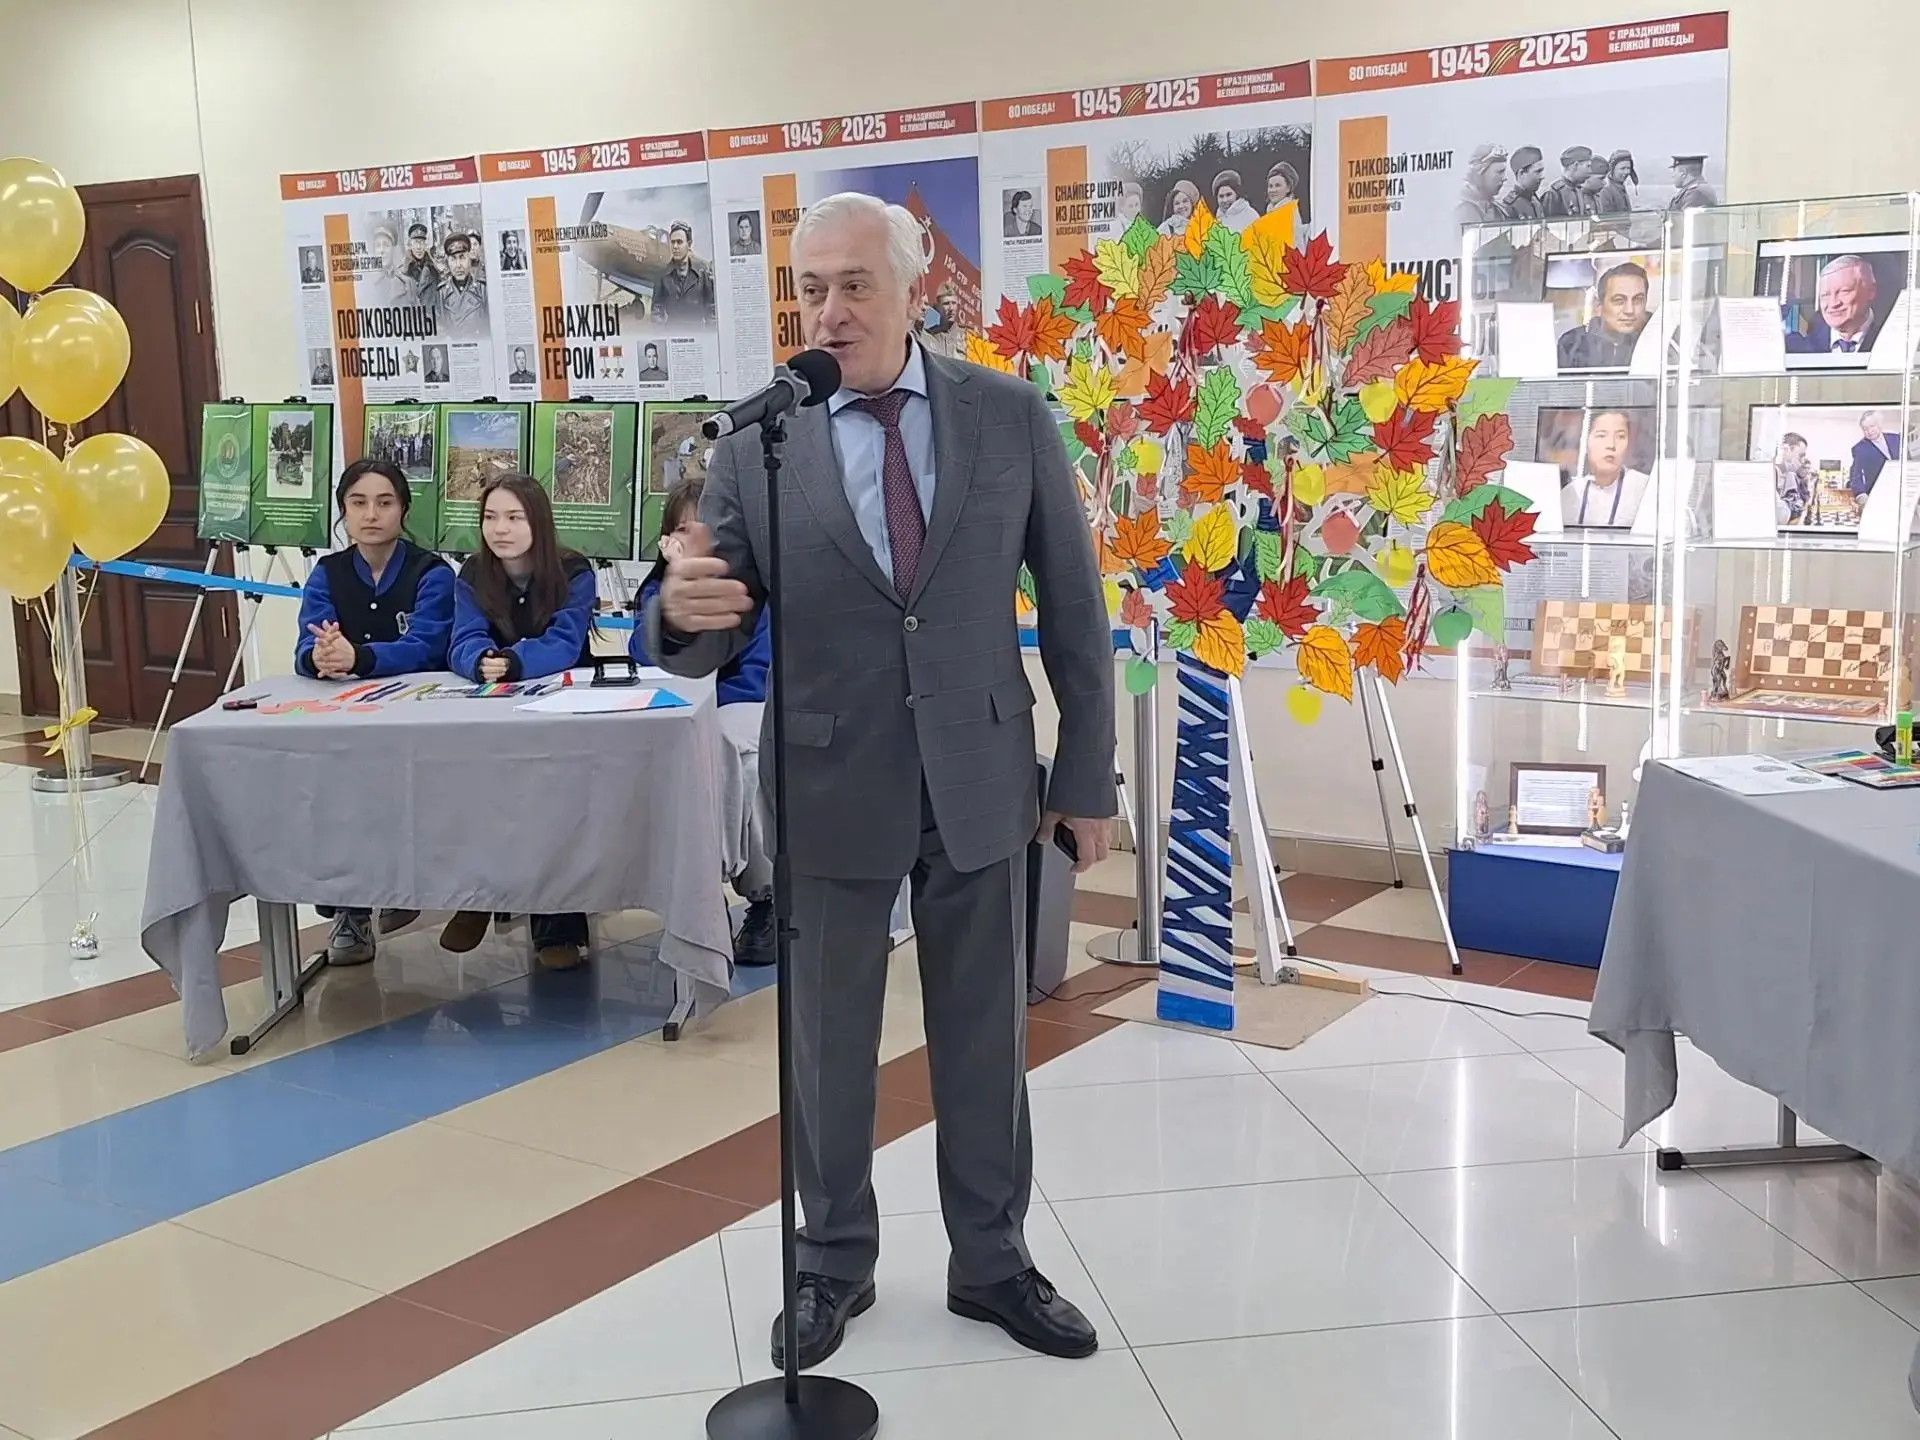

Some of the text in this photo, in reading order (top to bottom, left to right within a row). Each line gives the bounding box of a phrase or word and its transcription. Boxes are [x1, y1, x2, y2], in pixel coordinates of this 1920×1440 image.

[1609, 22, 1680, 41] С ПРАЗДНИКОМ
[1609, 33, 1694, 53] ВЕЛИКОЙ ПОБЕДЫ!
[1428, 31, 1588, 78] 1945 2025
[1349, 61, 1407, 81] 80 ПОБЕДА!
[1008, 102, 1056, 119] 80 ПОБЕДА!
[1072, 78, 1200, 117] 1945 2025
[729, 136, 740, 148] 80
[781, 114, 886, 148] 1945 2025
[541, 143, 631, 173] 1945 2025
[1348, 151, 1453, 178] ТАНКОВЫЙ ТАЛАНТ
[336, 165, 414, 192] 1945 2025
[1055, 181, 1124, 202] СНАЙПЕР ШУРА
[1348, 178, 1405, 199] КОМБРИГА
[771, 208, 800, 225] КОМБАТ
[1055, 202, 1116, 223] ИЗ ДЕГТЯРКИ
[534, 223, 608, 242] ГРОЗА НЕМЕЦКИХ АСОВ
[337, 305, 437, 341] ПОЛКОВОДЦЫ
[543, 303, 620, 343] ДВАЖДЫ
[778, 311, 802, 347] ЭП
[341, 346, 400, 381] ПОБЕДЫ
[544, 346, 595, 380] ГЕРОИ
